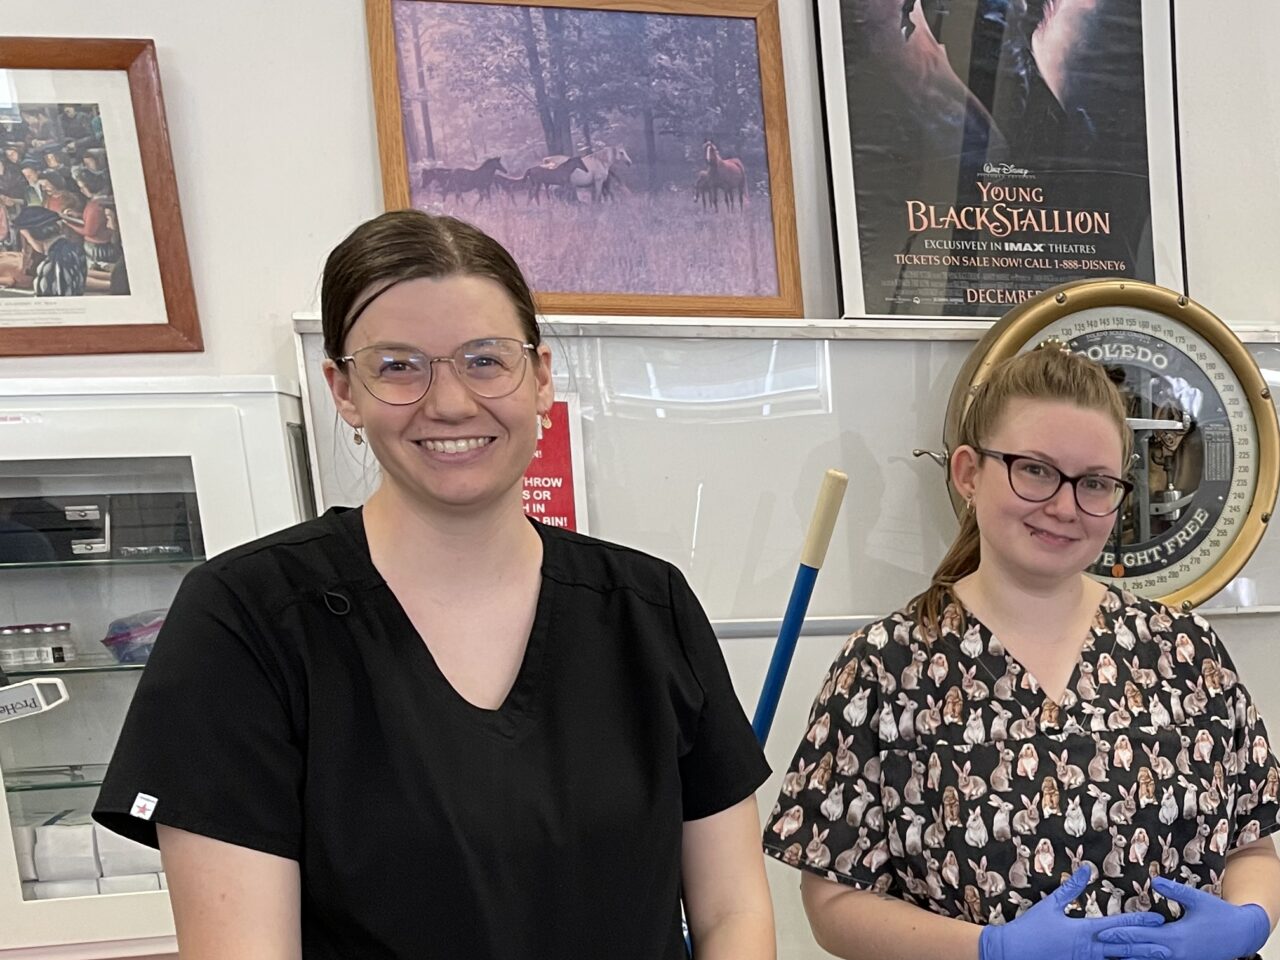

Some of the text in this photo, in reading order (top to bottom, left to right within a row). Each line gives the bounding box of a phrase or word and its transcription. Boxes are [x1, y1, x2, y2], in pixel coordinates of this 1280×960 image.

[924, 240, 1096, 254] EXCLUSIVELY IN IMAX THEATRES
[894, 254, 1126, 270] TICKETS ON SALE NOW! CALL 1-888-DISNEY6
[1077, 344, 1168, 369] OLEDO
[524, 476, 562, 488] HROW
[533, 490, 551, 500] OR
[532, 503, 545, 513] IN
[1101, 508, 1209, 567] EGHT FREE
